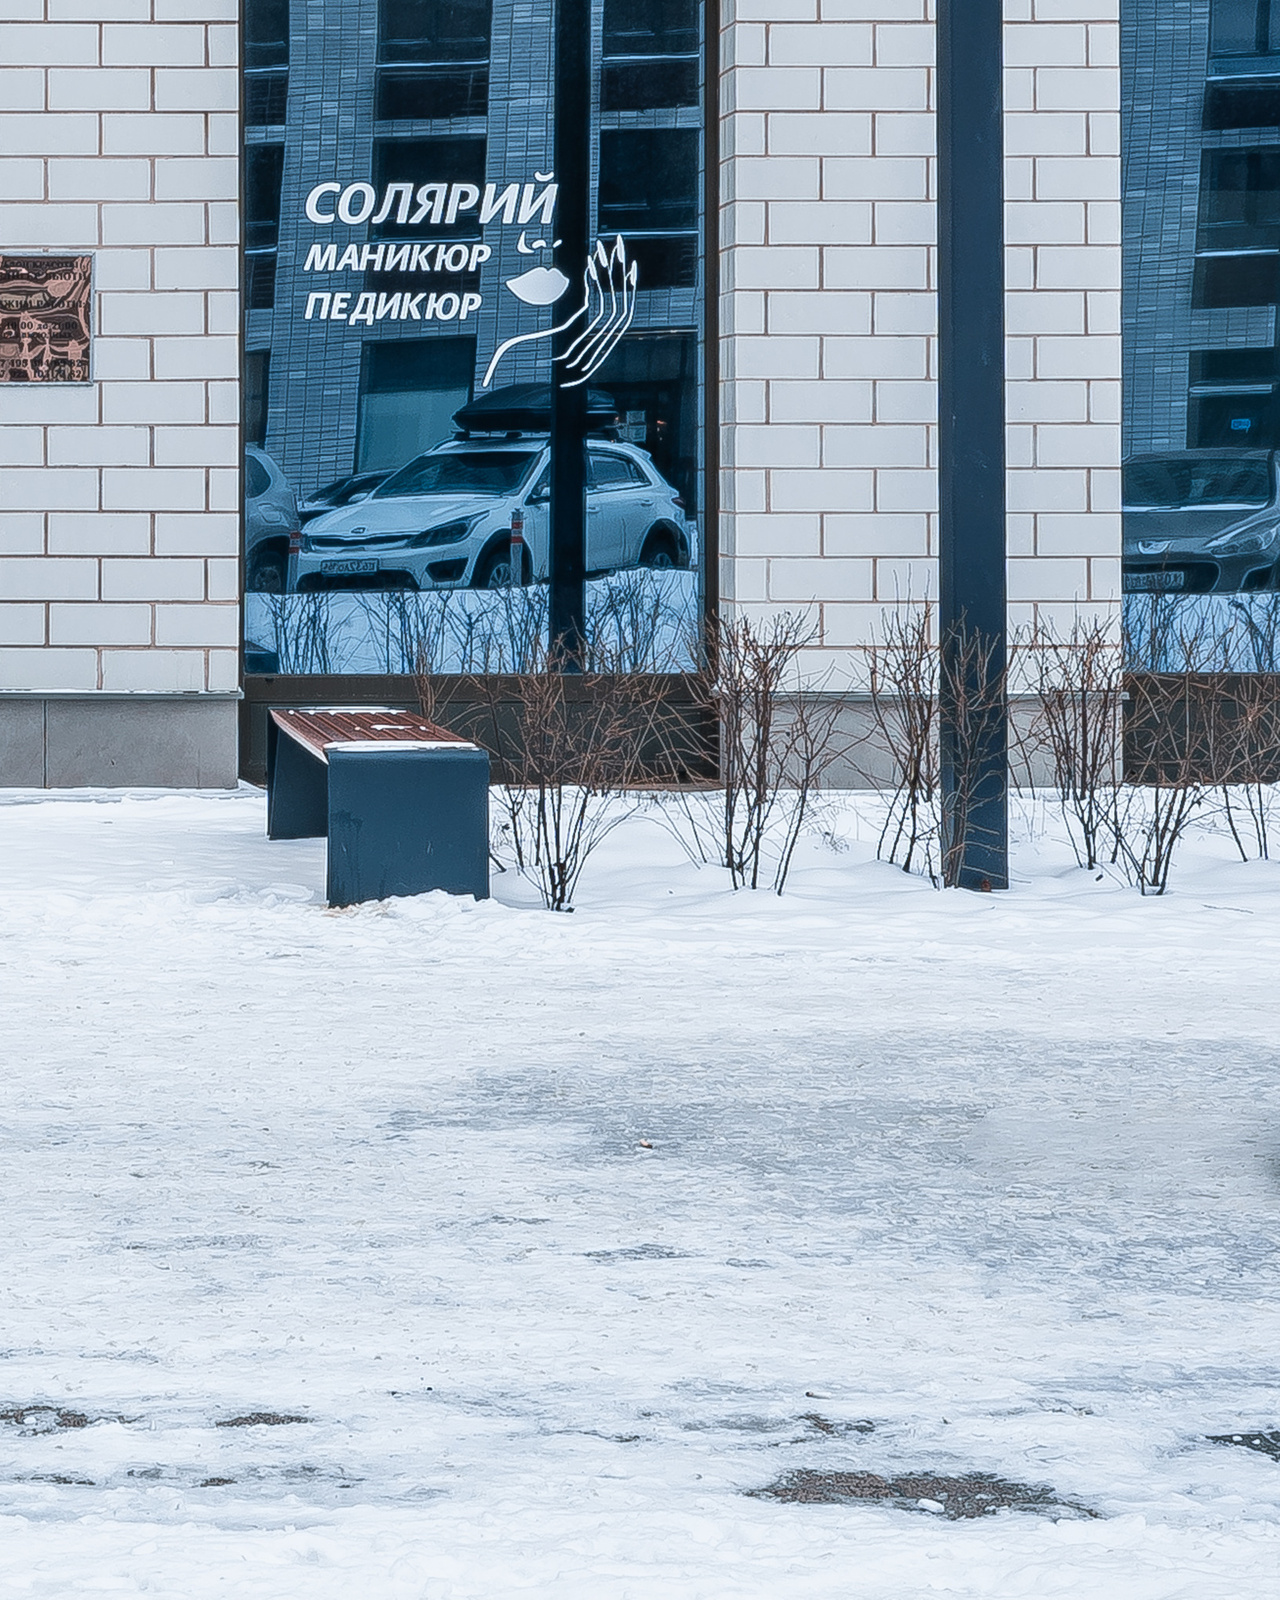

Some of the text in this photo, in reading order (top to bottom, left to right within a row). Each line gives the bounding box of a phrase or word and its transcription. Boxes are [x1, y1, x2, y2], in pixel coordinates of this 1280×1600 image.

[304, 171, 559, 225] СОЛЯРИЙ
[303, 243, 492, 272] МАНИКЮР
[304, 292, 482, 326] ПЕДИКЮР
